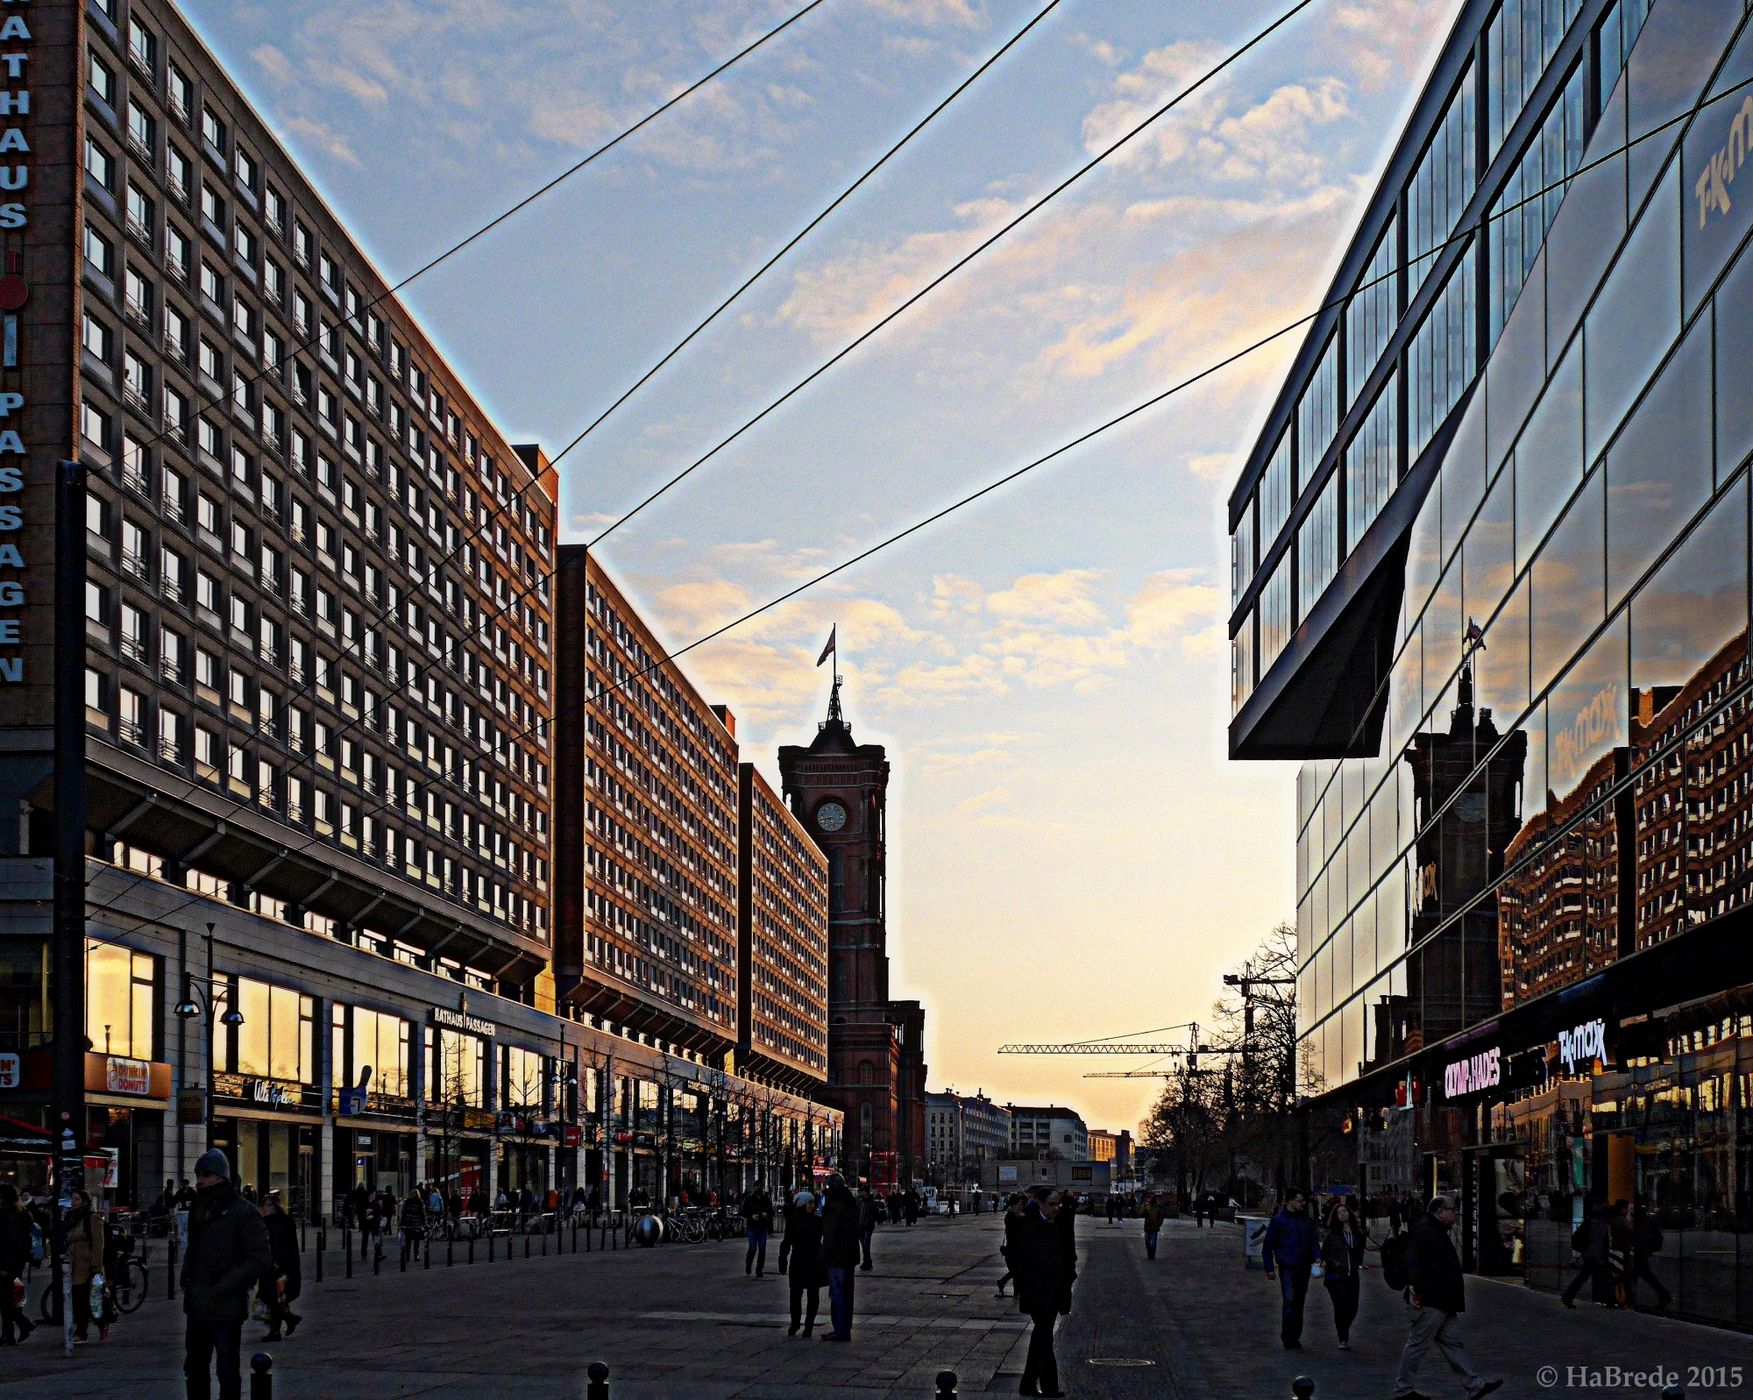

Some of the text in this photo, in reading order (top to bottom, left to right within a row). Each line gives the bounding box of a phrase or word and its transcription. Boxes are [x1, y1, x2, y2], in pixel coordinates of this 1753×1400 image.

[0, 0, 32, 230] ATHAUS
[0, 392, 27, 686] PASSAGEN
[434, 1007, 496, 1037] RATHAUS PASSAGEN
[118, 1077, 147, 1092] DONUTS
[1444, 1059, 1470, 1099] OLYMP
[1471, 1046, 1501, 1092] HADES
